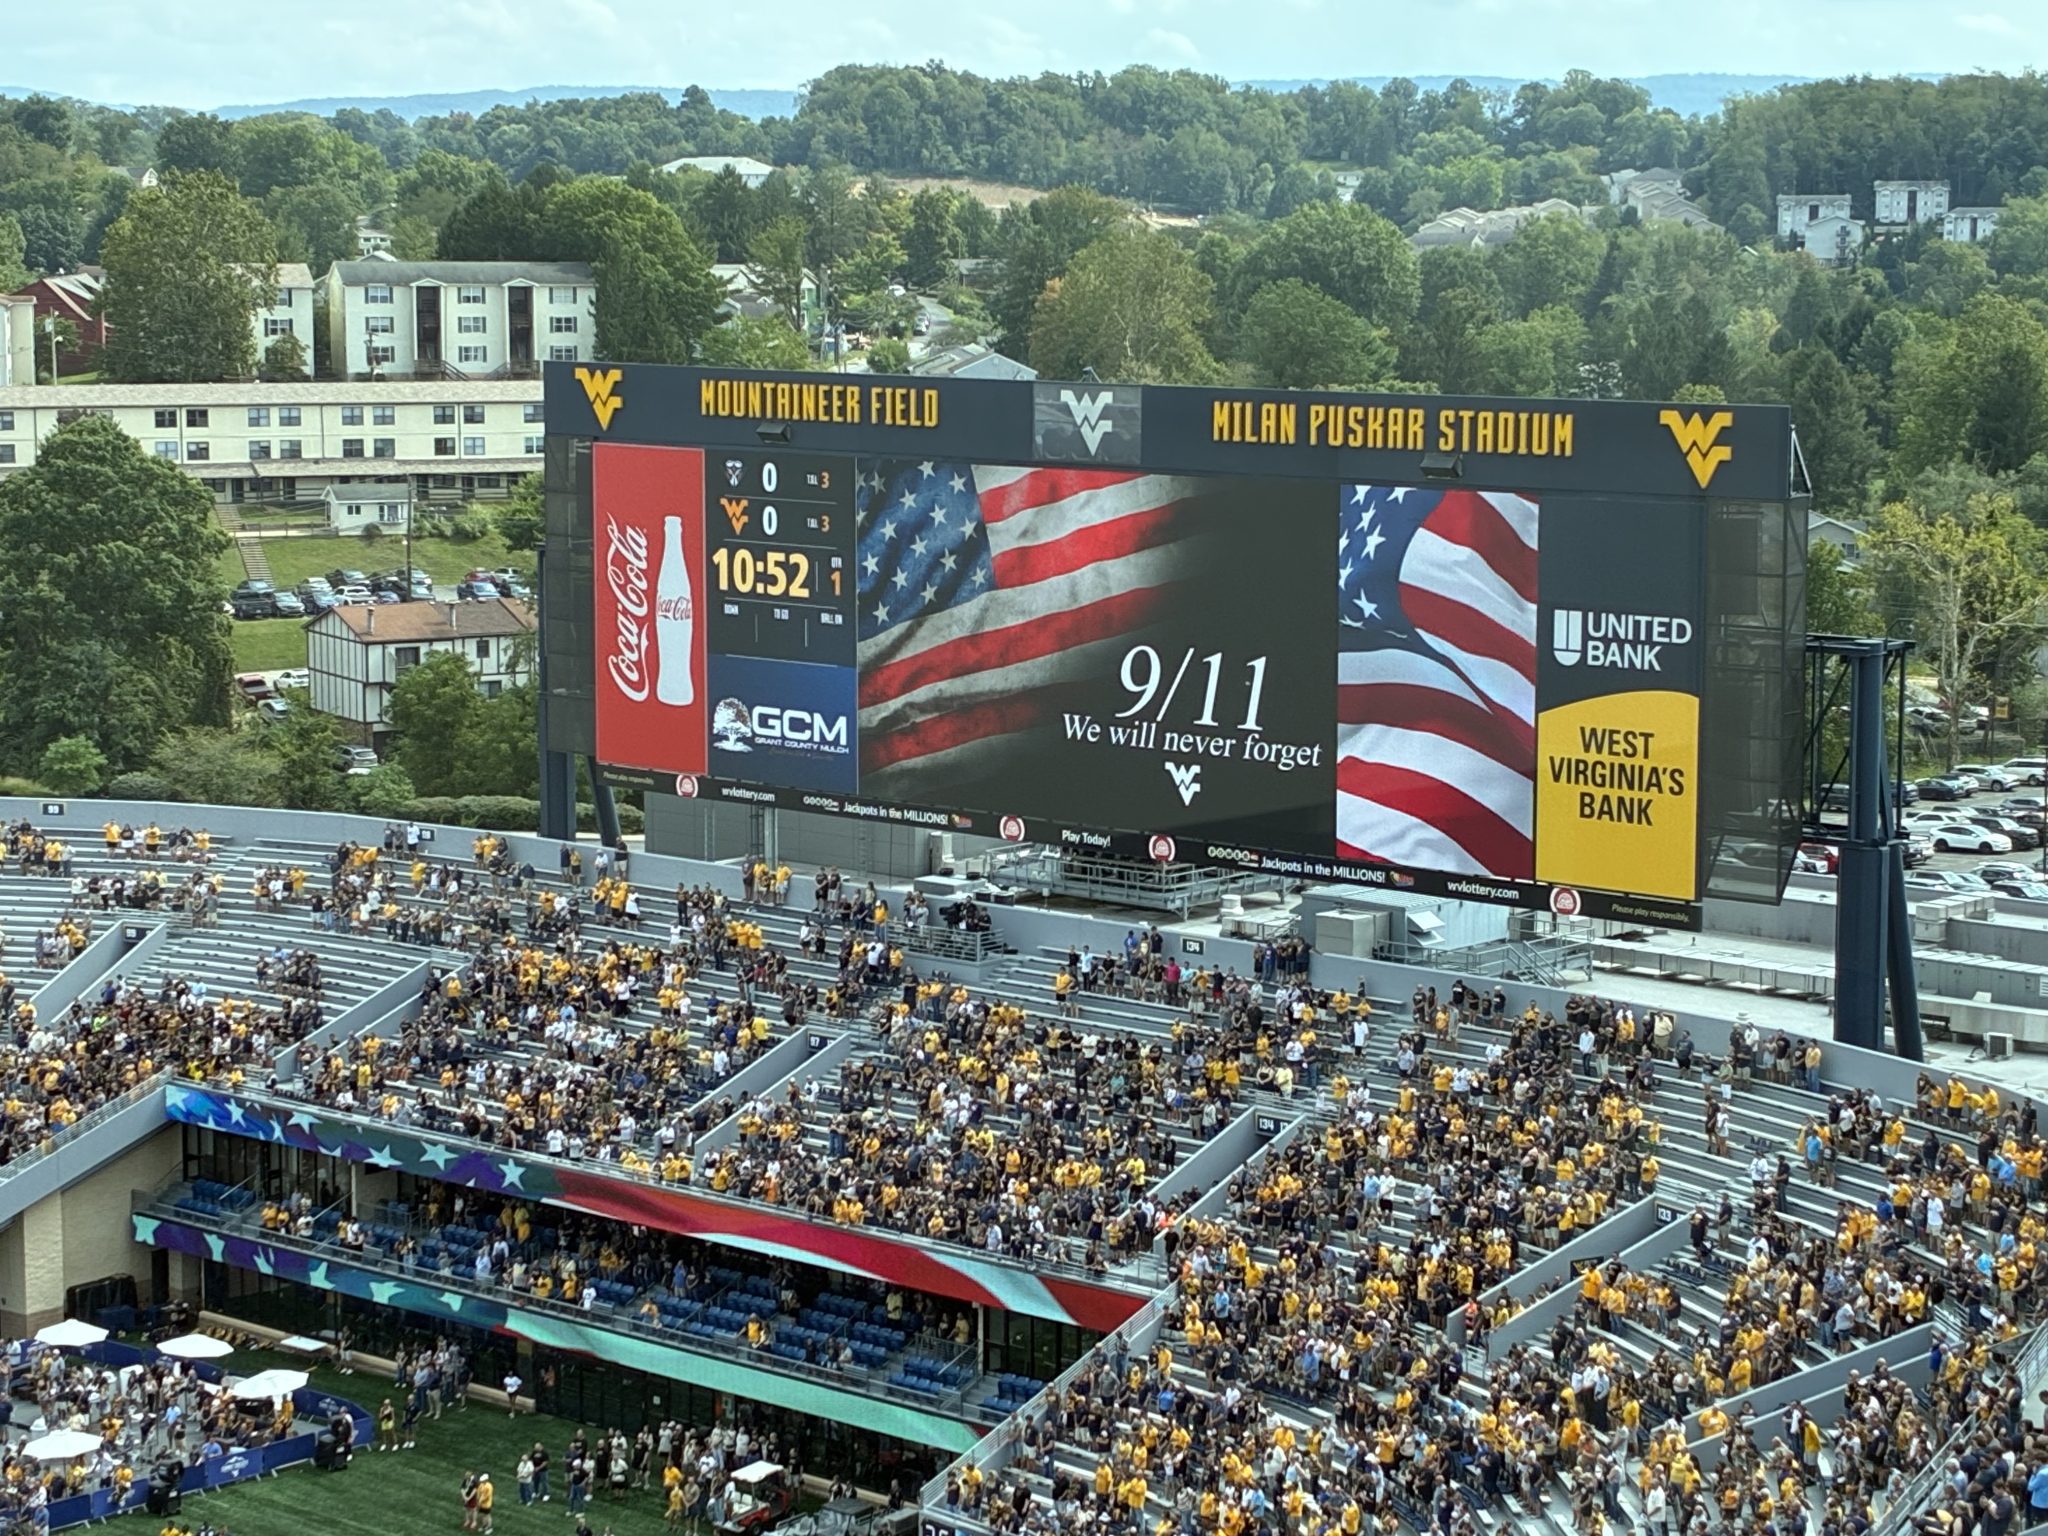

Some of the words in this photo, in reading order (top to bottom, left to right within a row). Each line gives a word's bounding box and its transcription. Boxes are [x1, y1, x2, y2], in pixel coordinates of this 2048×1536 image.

[700, 379, 861, 424] MOUNTAINEER
[870, 386, 939, 428] FIELD
[1213, 400, 1296, 445] MILAN
[1309, 405, 1425, 451] PUSKAR
[1439, 410, 1573, 458] STADIUM
[762, 462, 778, 492] 0
[821, 471, 830, 489] 3
[762, 505, 778, 536] 0
[821, 515, 830, 532] 3
[712, 547, 810, 598] 10:52
[830, 570, 842, 596] 1
[607, 512, 650, 702] Coca-Cola
[1587, 612, 1693, 645] UNITED
[1586, 643, 1661, 672] BANK
[1115, 645, 1267, 731] 9/11
[752, 705, 847, 746] GCM
[754, 736, 783, 746] GRANT
[784, 740, 818, 750] COUNTY
[820, 744, 850, 754] MULCH
[1062, 713, 1101, 743] We
[1109, 721, 1157, 749] will
[1163, 732, 1236, 758] never
[1243, 733, 1323, 771] forget
[1579, 726, 1655, 760] WEST
[1549, 756, 1685, 797] VIRGINIA'S
[722, 787, 776, 802] wvlottery.com
[843, 801, 878, 817] Jackpots
[879, 805, 888, 817] in
[889, 807, 902, 820] the
[903, 809, 949, 825] MILLIONS!
[1579, 792, 1654, 827] BANK
[1062, 829, 1080, 844] Play
[1081, 832, 1111, 848] Today!
[1261, 855, 1302, 873] Jackpots
[1304, 860, 1313, 874] in
[1315, 863, 1331, 877] the
[1333, 865, 1386, 884] MILLIONS!
[1447, 880, 1520, 901] wvlottery.com
[1611, 903, 1634, 914] Please
[1635, 906, 1649, 917] play
[1186, 940, 1200, 952] 134
[1259, 1118, 1275, 1131] 134
[1658, 1208, 1672, 1222] 133
